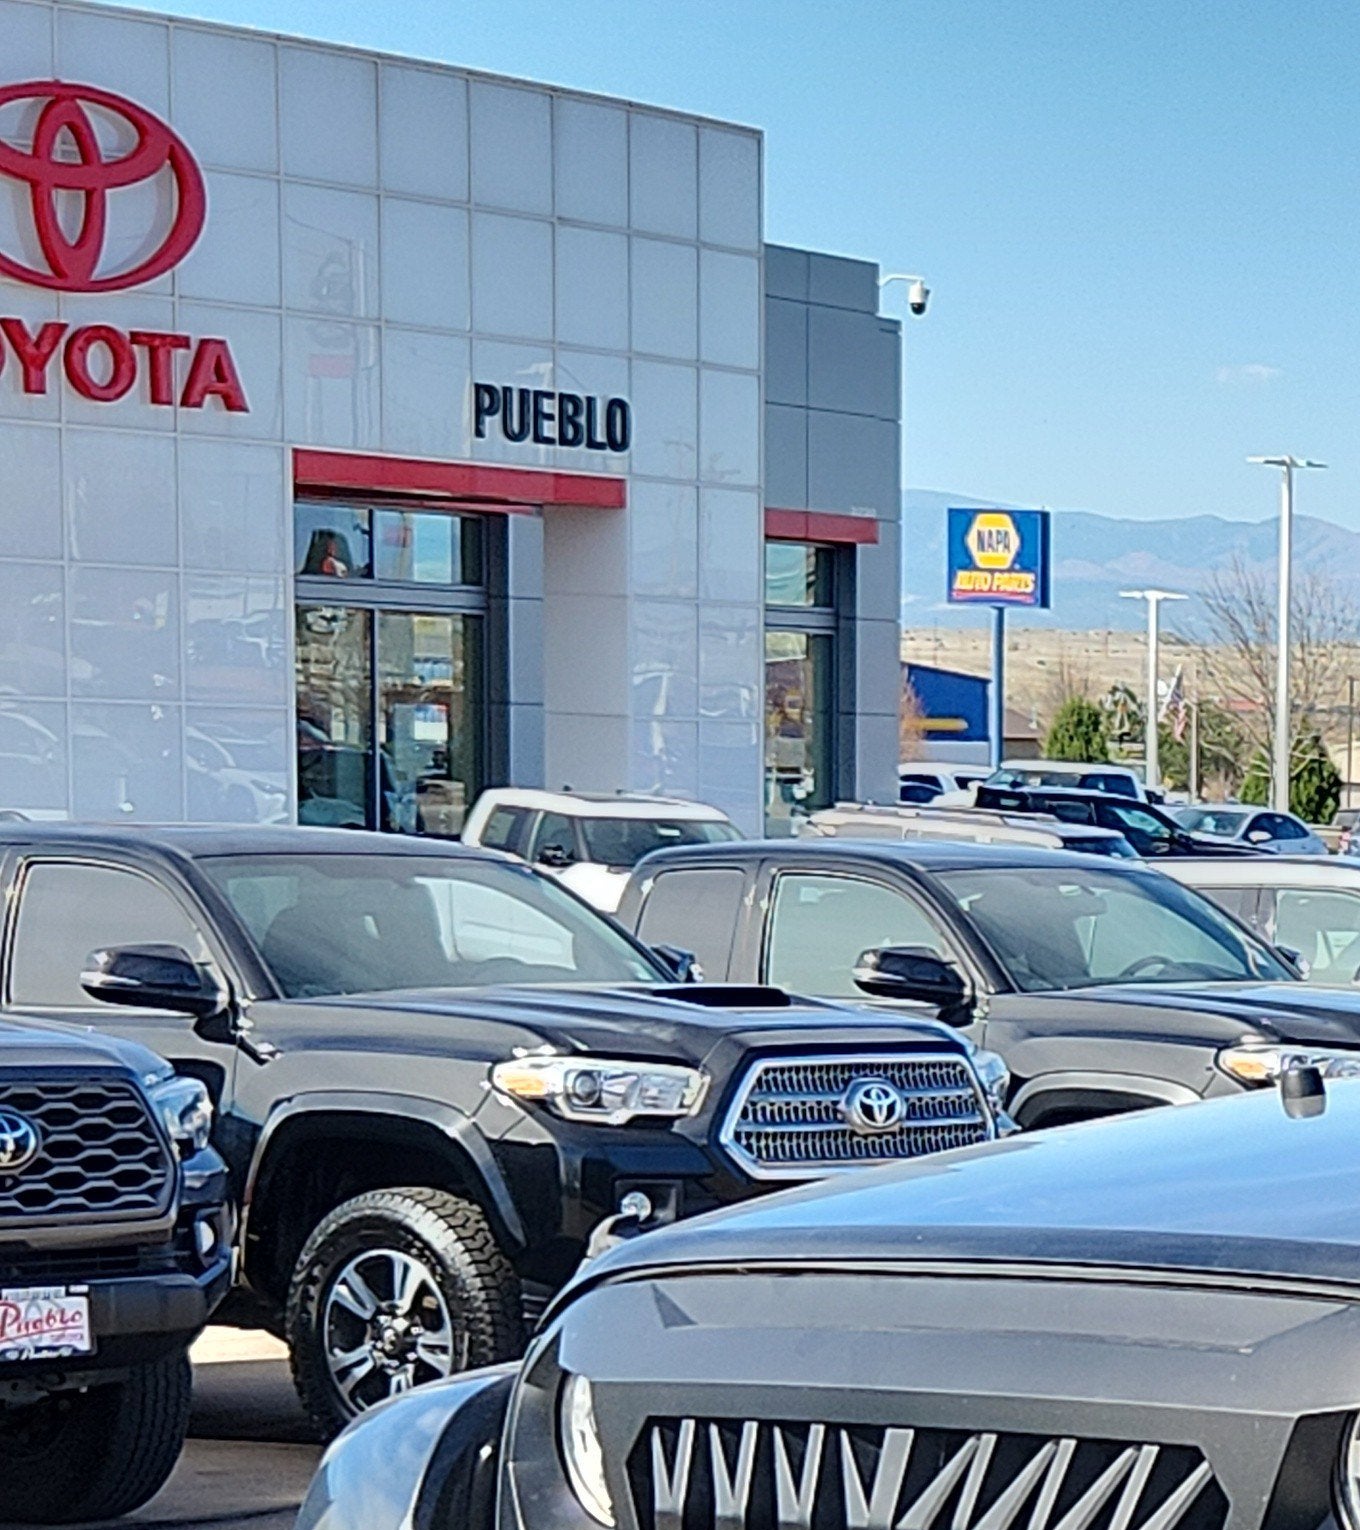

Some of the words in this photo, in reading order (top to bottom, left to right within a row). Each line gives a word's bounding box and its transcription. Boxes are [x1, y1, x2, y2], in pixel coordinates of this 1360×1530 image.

[0, 317, 250, 412] YOTA
[474, 382, 632, 452] PUEBLO
[976, 529, 1011, 553] NAPA
